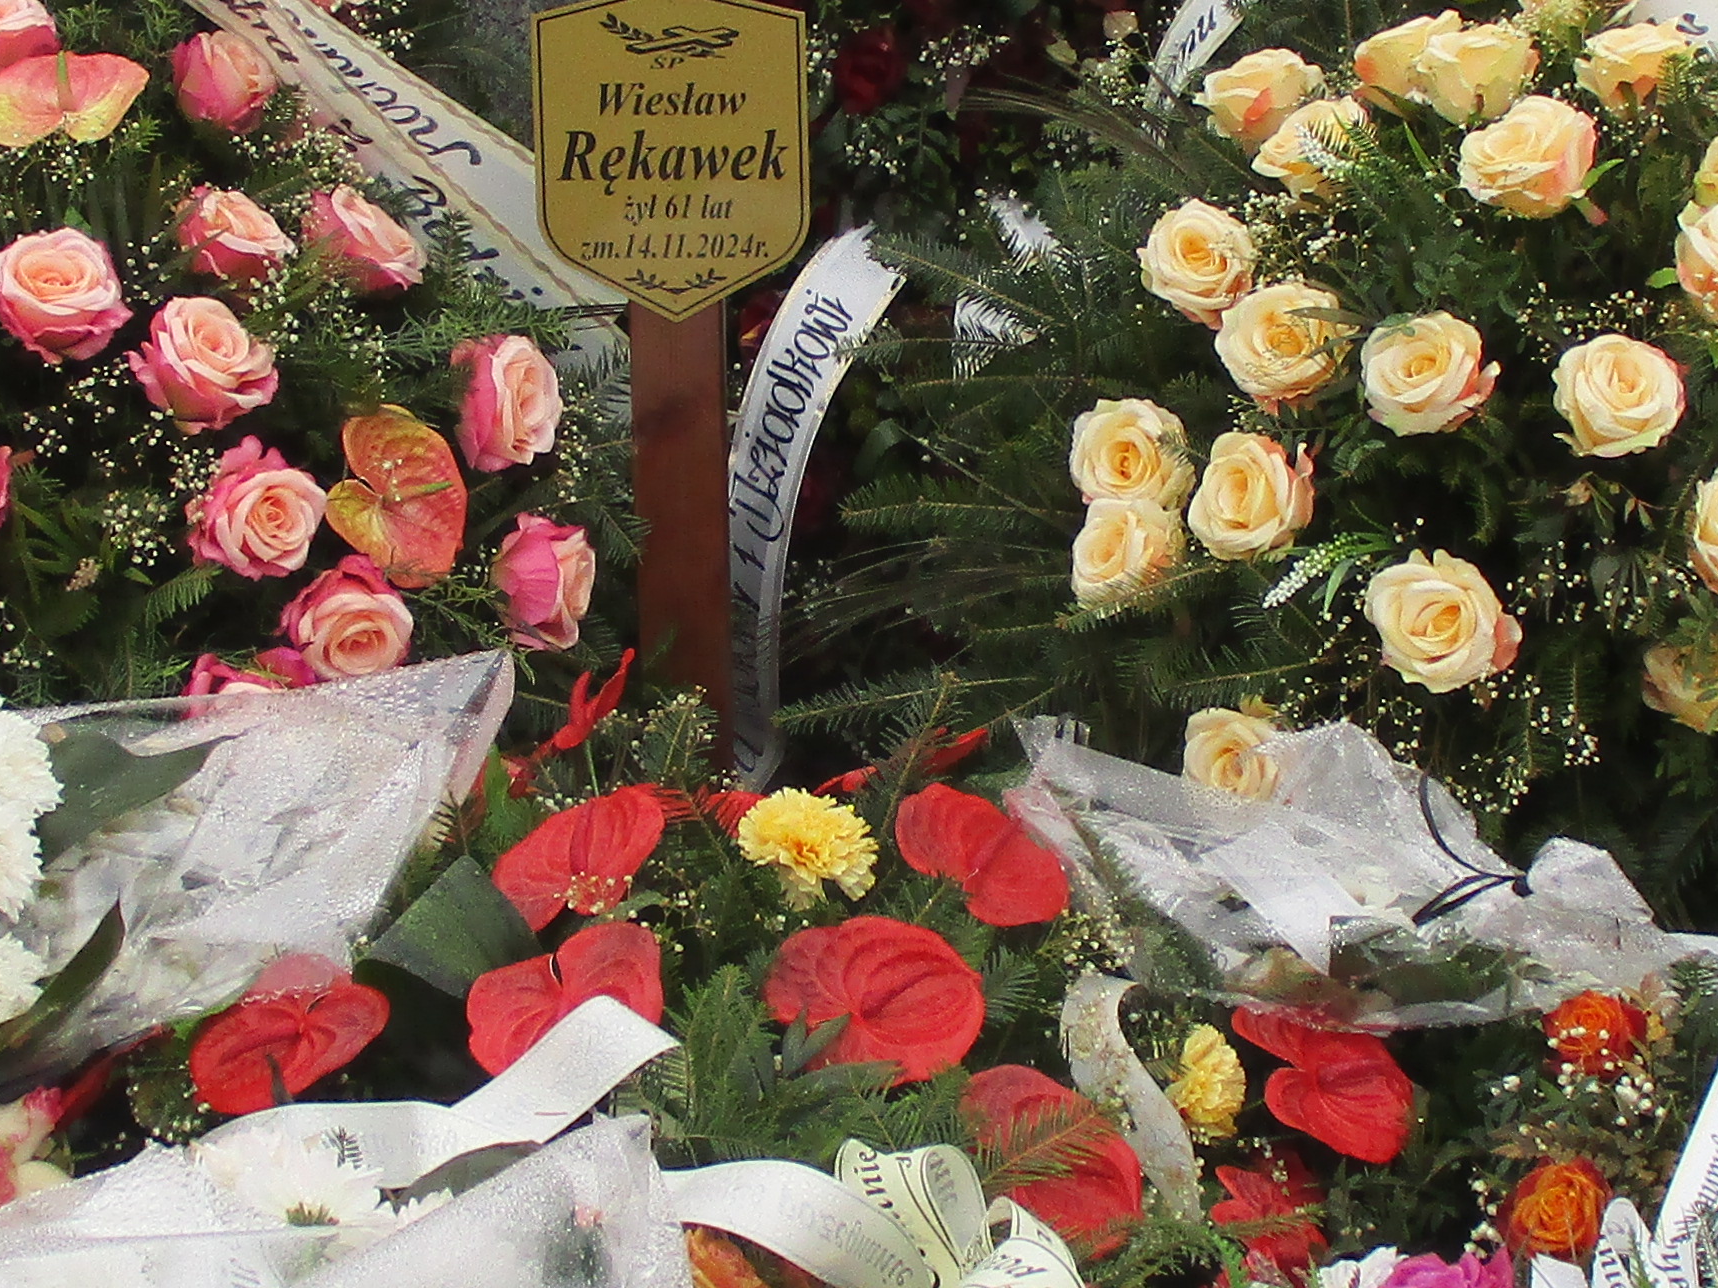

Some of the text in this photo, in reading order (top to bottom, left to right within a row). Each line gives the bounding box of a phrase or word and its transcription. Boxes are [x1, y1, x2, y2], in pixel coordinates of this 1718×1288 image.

[598, 82, 746, 116] Wiesław
[557, 130, 789, 195] Rękawek
[623, 195, 733, 226] żył 61 lat
[581, 233, 770, 261] zm.14.11.2024r.
